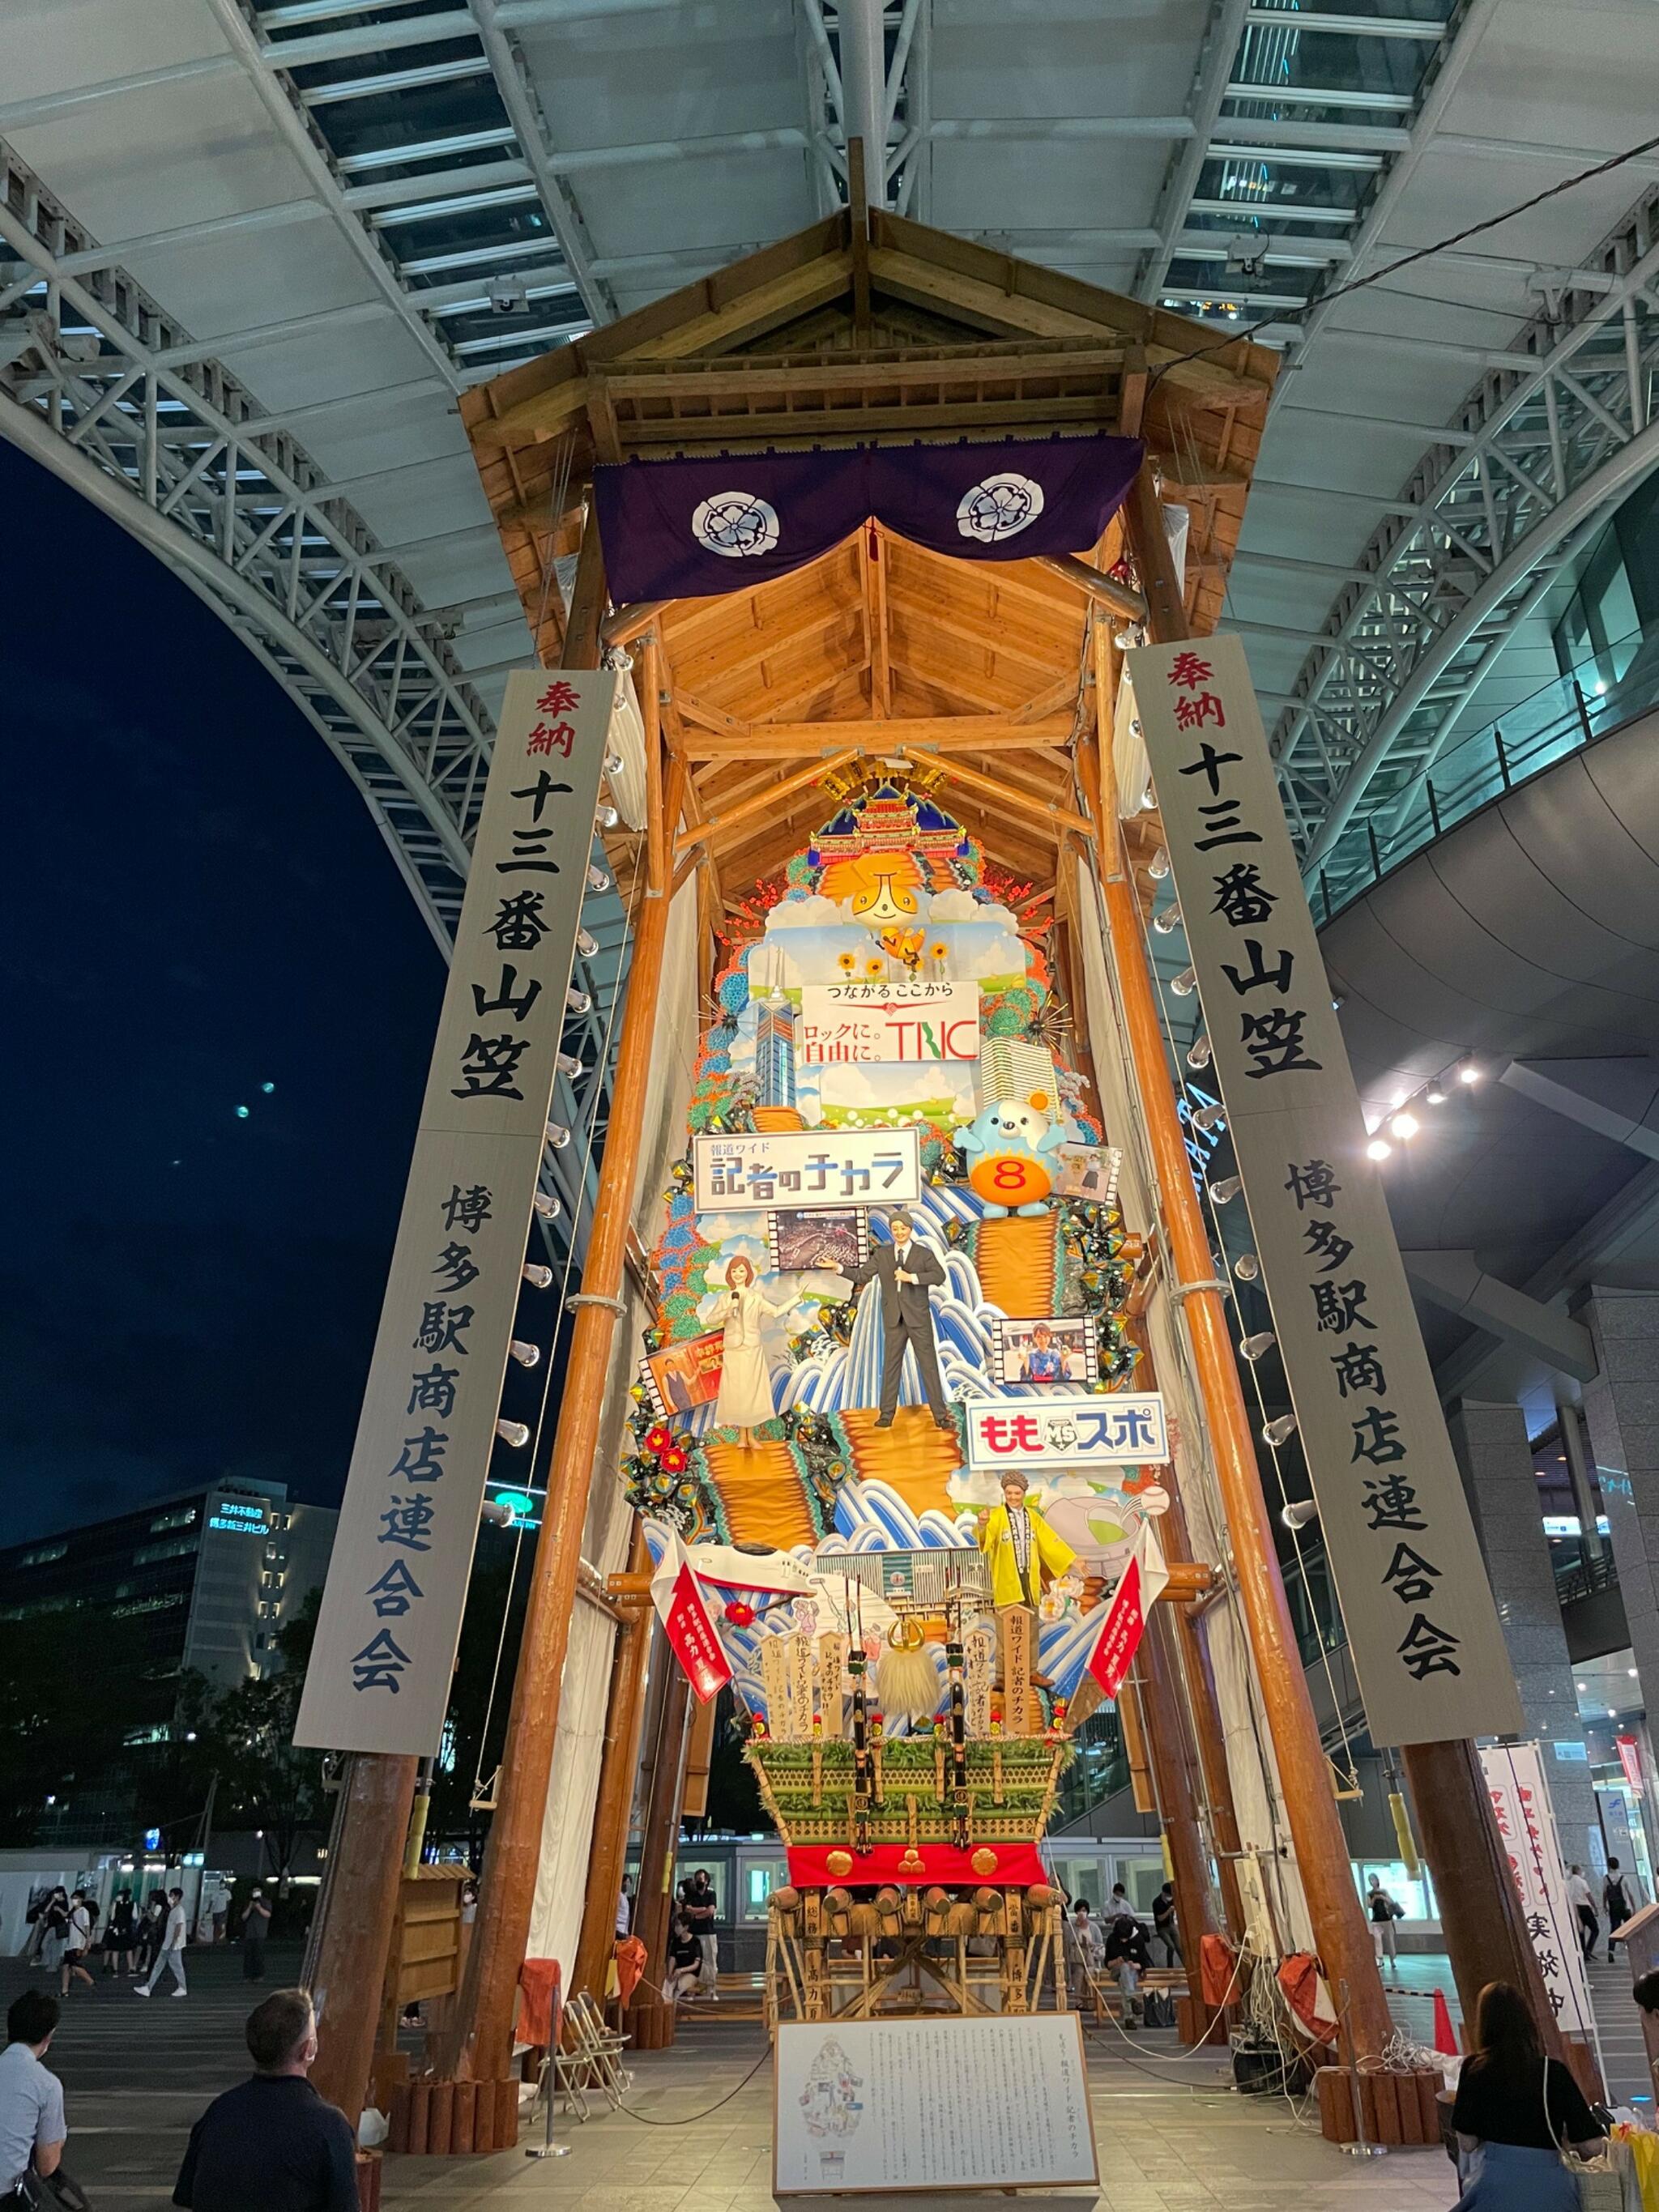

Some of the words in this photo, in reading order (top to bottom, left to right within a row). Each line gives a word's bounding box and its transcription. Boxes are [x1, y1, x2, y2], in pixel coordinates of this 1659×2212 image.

[1167, 651, 1226, 732] 奉納
[526, 680, 581, 760] 奉納
[1178, 742, 1324, 1080] 十三番山笠
[450, 769, 574, 1102] 十三番山笠
[827, 983, 890, 999] つながる
[896, 982, 953, 998] ここから
[804, 1022, 881, 1041] ロックに。
[805, 1041, 881, 1063] 自由に。
[885, 1020, 979, 1061] TNC
[710, 1141, 770, 1157] 報道ワイド
[710, 1152, 904, 1201] 記者のチカラ
[993, 1160, 1026, 1190] 8
[349, 1184, 493, 1694] 博多駅商店連合会
[979, 1413, 1045, 1454] もも
[1075, 1408, 1156, 1451] スポ
[1284, 1158, 1461, 1681] 博多駅商店連合会
[209, 1516, 270, 1535] 博多新三井ビル
[220, 1502, 263, 1519] 三井不動産
[1010, 1615, 1024, 1664] 報道ワイド
[1011, 1666, 1026, 1724] 記者のチカラ
